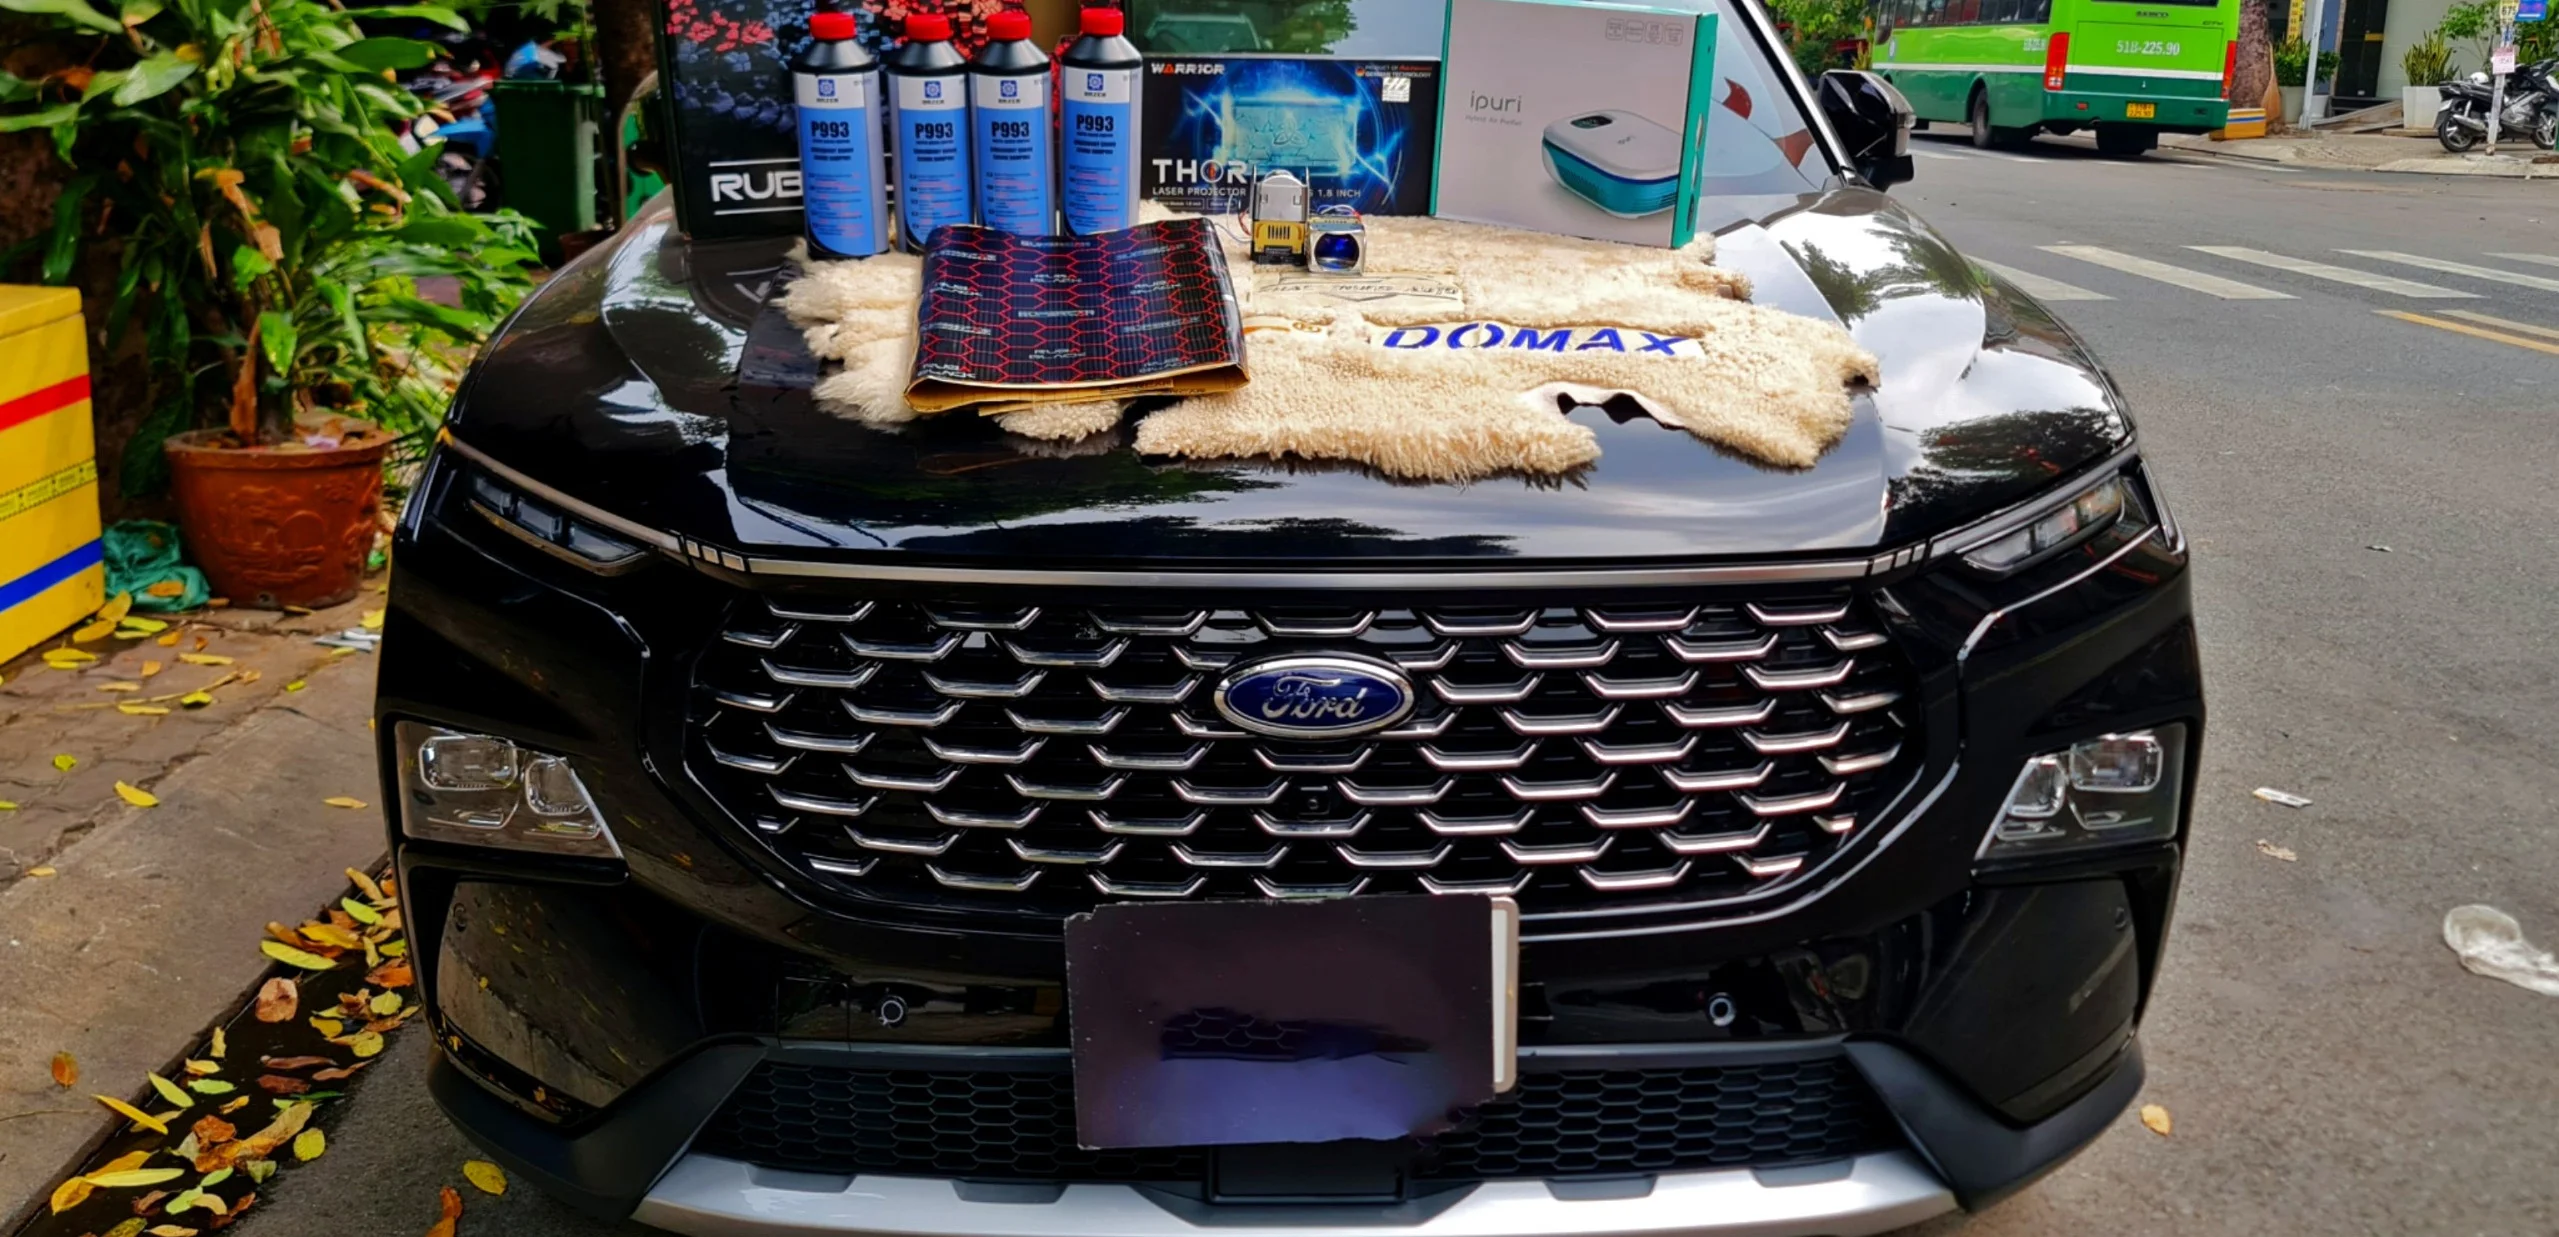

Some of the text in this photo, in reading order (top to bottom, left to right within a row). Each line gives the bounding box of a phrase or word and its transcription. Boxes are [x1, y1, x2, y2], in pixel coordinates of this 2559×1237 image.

[1470, 90, 1522, 113] ipuri
[811, 120, 849, 138] P993
[915, 122, 953, 139] P993
[991, 121, 1029, 138] P993
[1076, 114, 1114, 132] P993
[1152, 159, 1248, 184] THOR
[710, 170, 803, 201] RUB
[1152, 187, 1184, 196] LASER
[1187, 187, 1247, 197] PROJECTOR
[1318, 188, 1333, 198] 1.8
[1336, 189, 1361, 198] INCH
[1383, 322, 1689, 356] DOMAX
[1262, 675, 1368, 719] Ford
